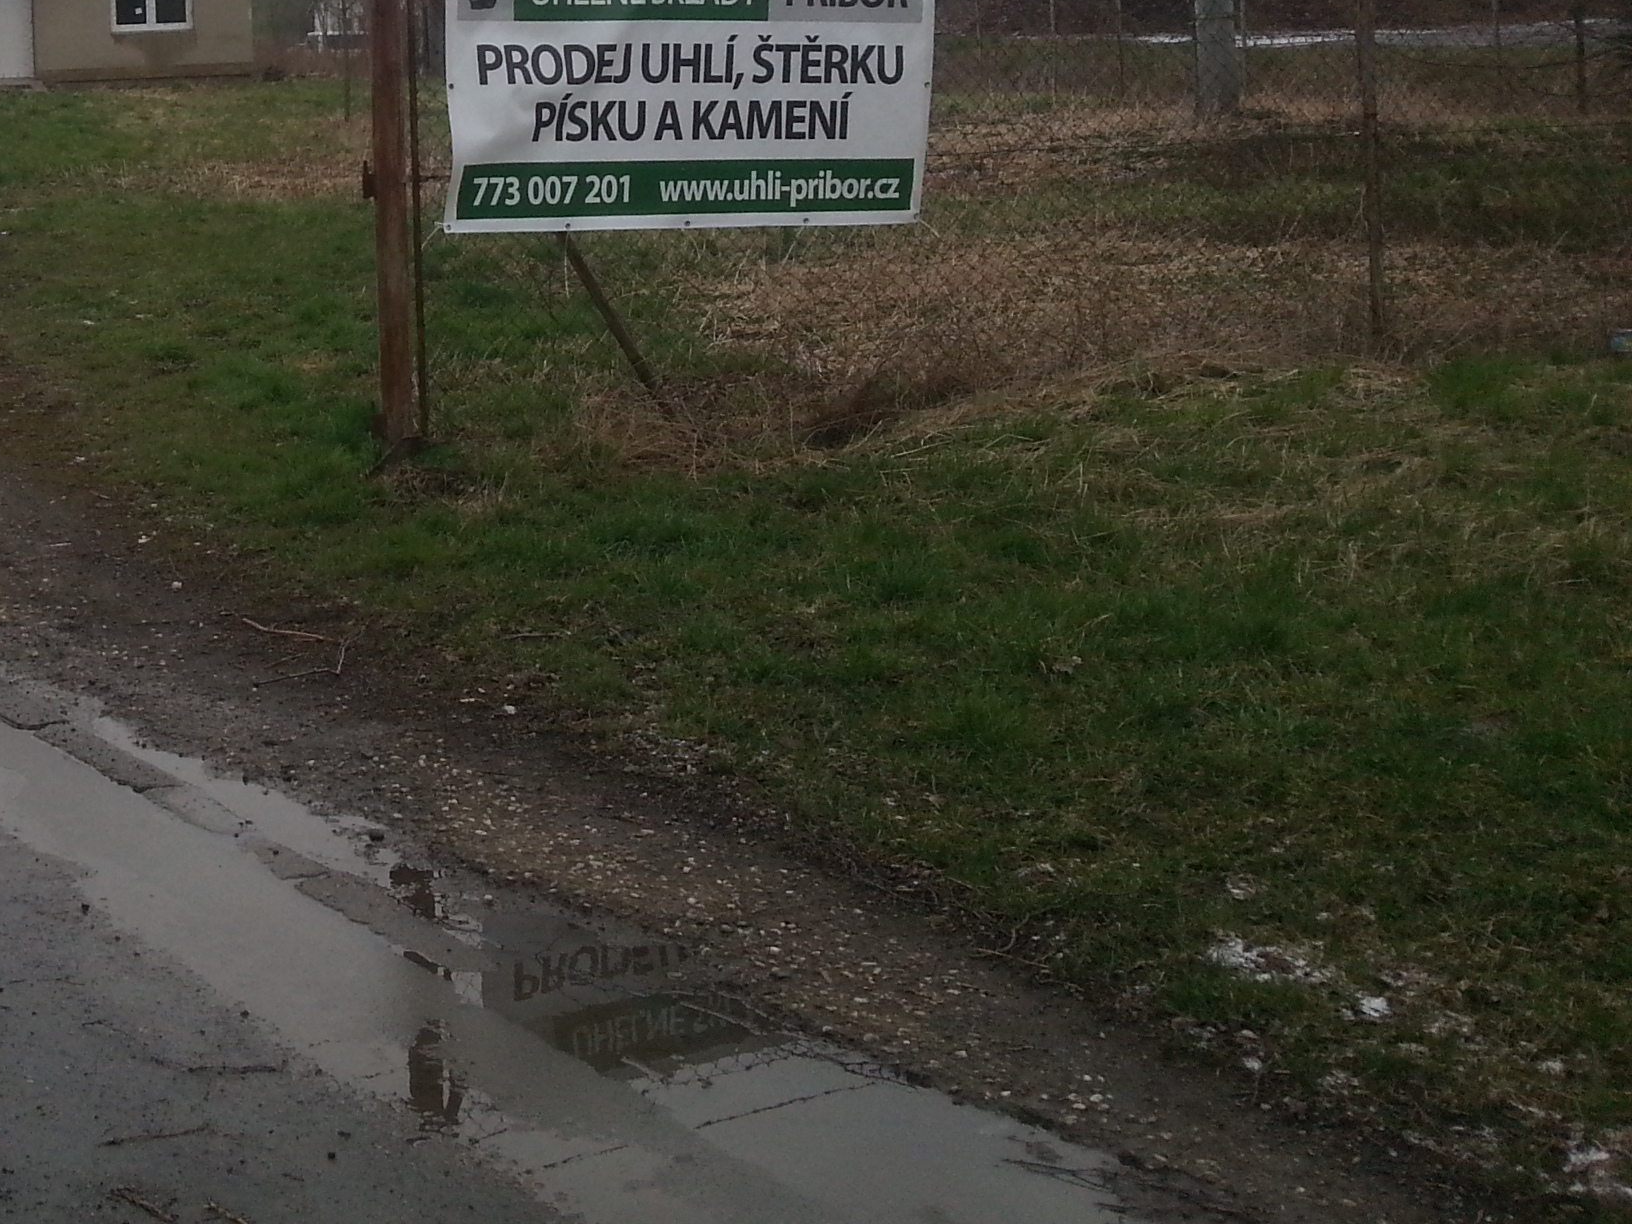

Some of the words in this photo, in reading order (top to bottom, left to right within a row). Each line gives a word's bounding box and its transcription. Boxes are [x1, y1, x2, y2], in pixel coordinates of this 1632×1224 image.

[476, 43, 632, 85] PRODEJ
[641, 34, 744, 90] UHLÍ,
[752, 34, 904, 85] ŠTĚRKU
[532, 93, 647, 142] PÍSKU
[653, 100, 683, 141] A
[692, 91, 853, 140] KAMENÍ
[473, 176, 520, 206] 773
[527, 175, 578, 205] 007
[585, 175, 631, 204] 201
[660, 170, 900, 207] www.uhli-pribor.cz
